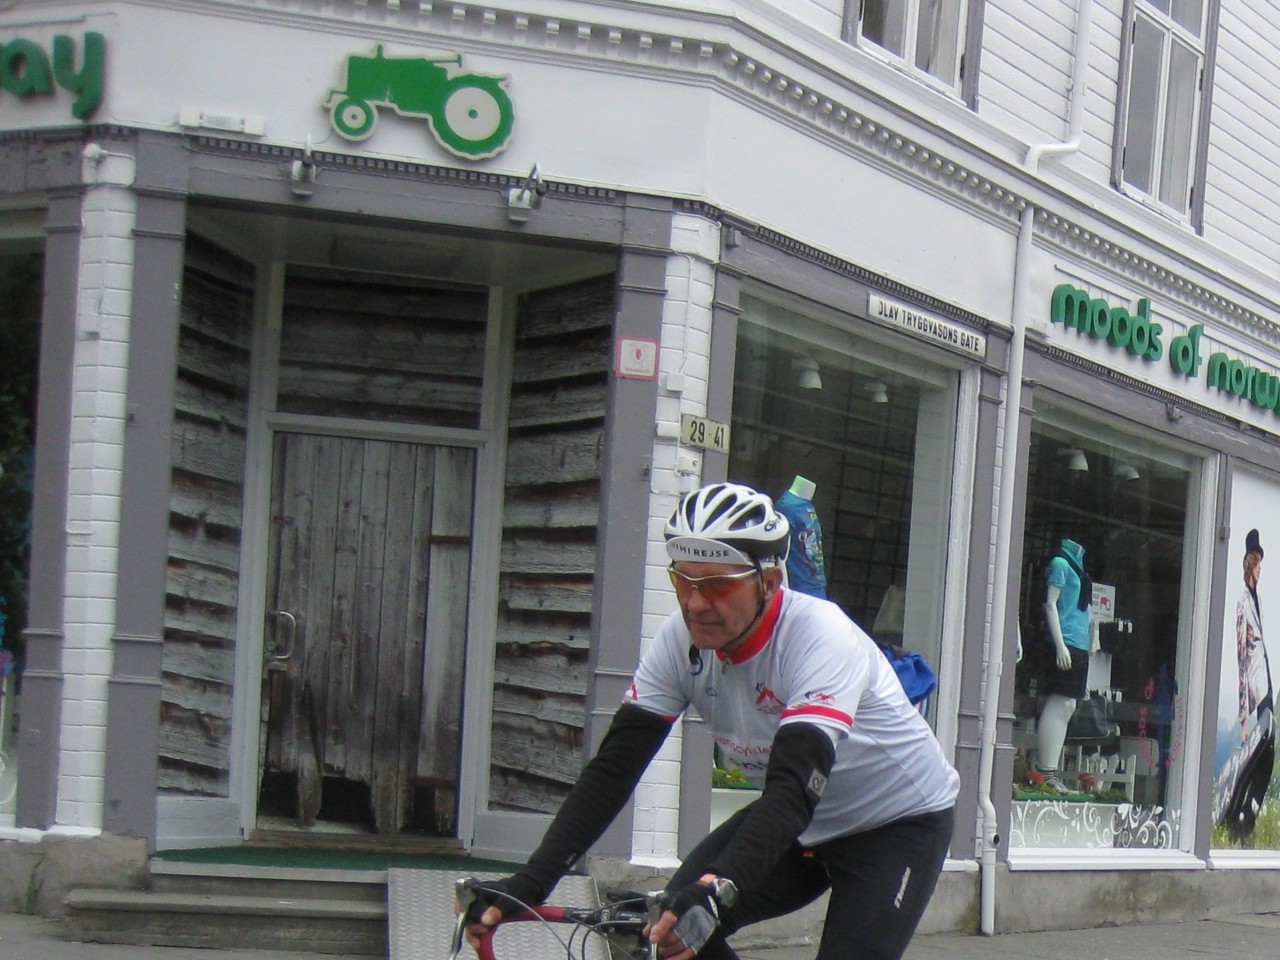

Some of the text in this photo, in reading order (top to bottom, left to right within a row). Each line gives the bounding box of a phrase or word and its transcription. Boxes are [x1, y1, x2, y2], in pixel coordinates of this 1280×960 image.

[0, 31, 105, 120] ay
[902, 309, 958, 344] TRYGGVASONS
[960, 331, 980, 352] GATE
[1051, 283, 1163, 362] moods
[1170, 324, 1204, 377] of
[693, 548, 730, 558] REJSE
